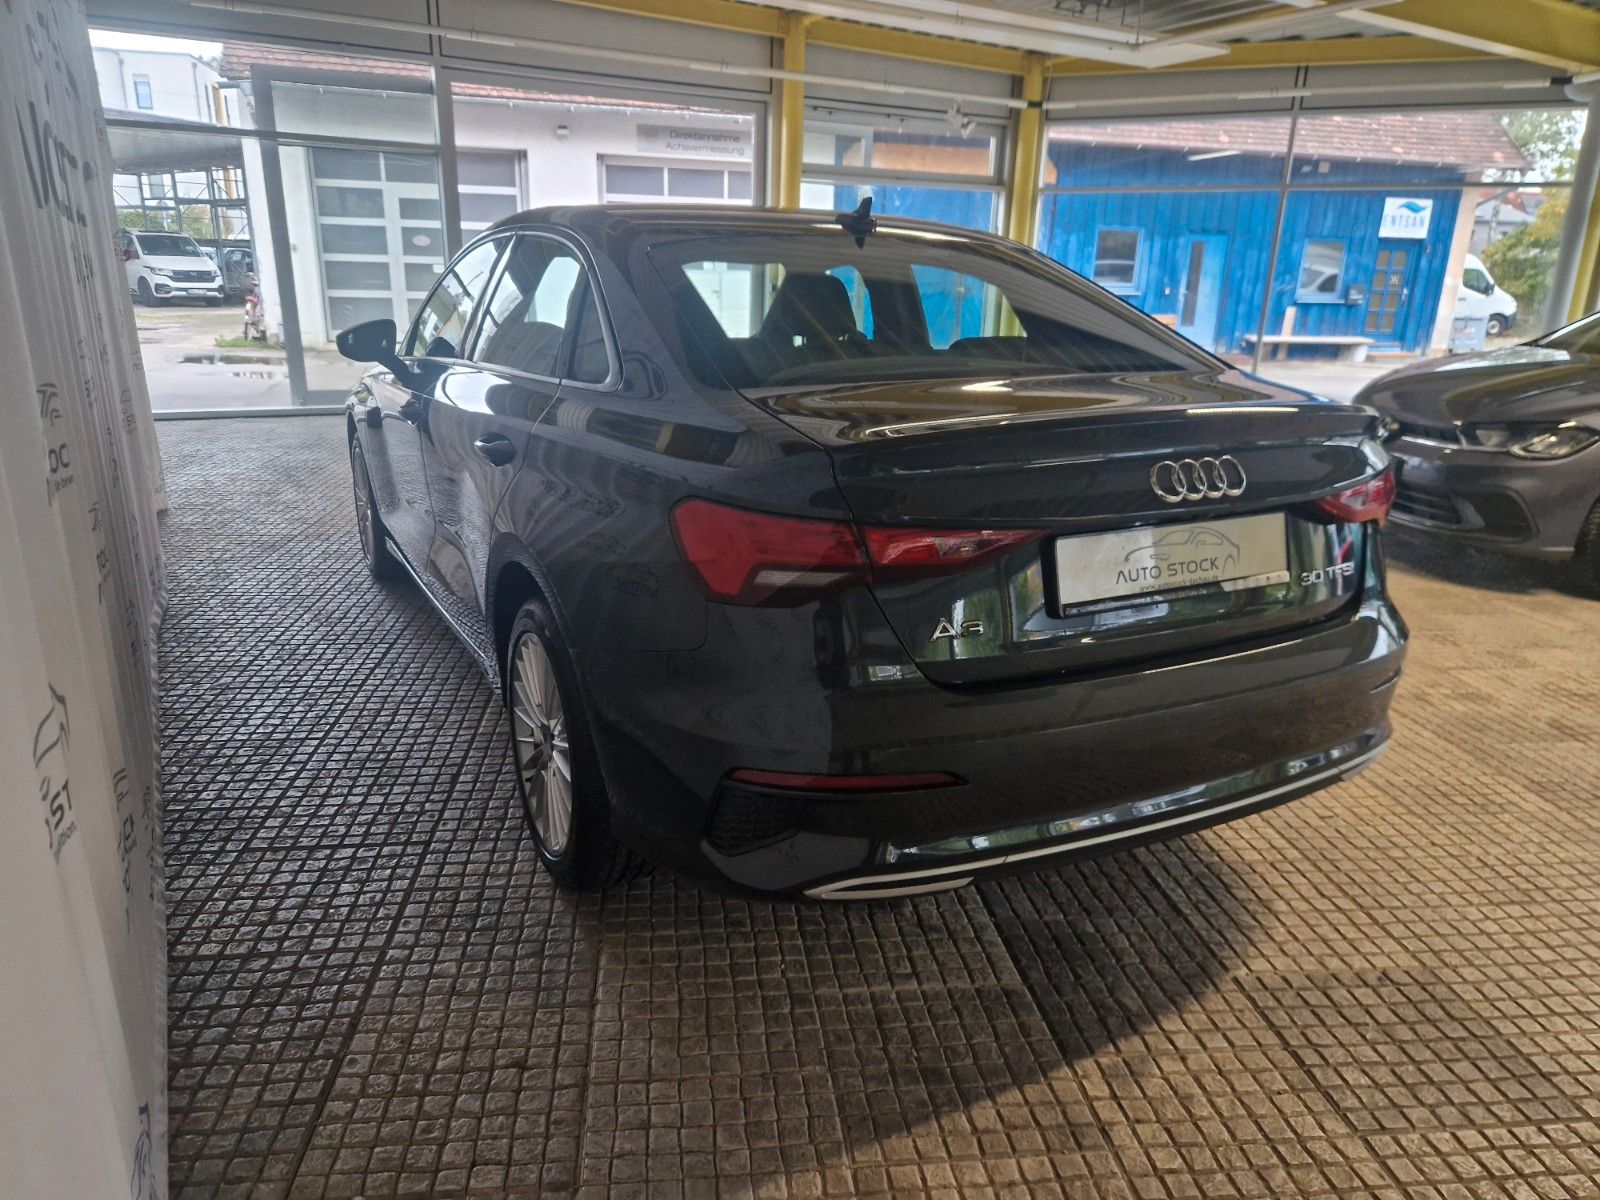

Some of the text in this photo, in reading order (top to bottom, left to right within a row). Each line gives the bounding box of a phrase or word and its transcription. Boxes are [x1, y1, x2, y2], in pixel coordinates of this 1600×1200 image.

[670, 129, 741, 143] Direktannahme
[1116, 556, 1219, 585] AUTO STOCK
[1300, 569, 1324, 586] 30
[1325, 561, 1355, 579] TFSI
[930, 617, 984, 642] A3
